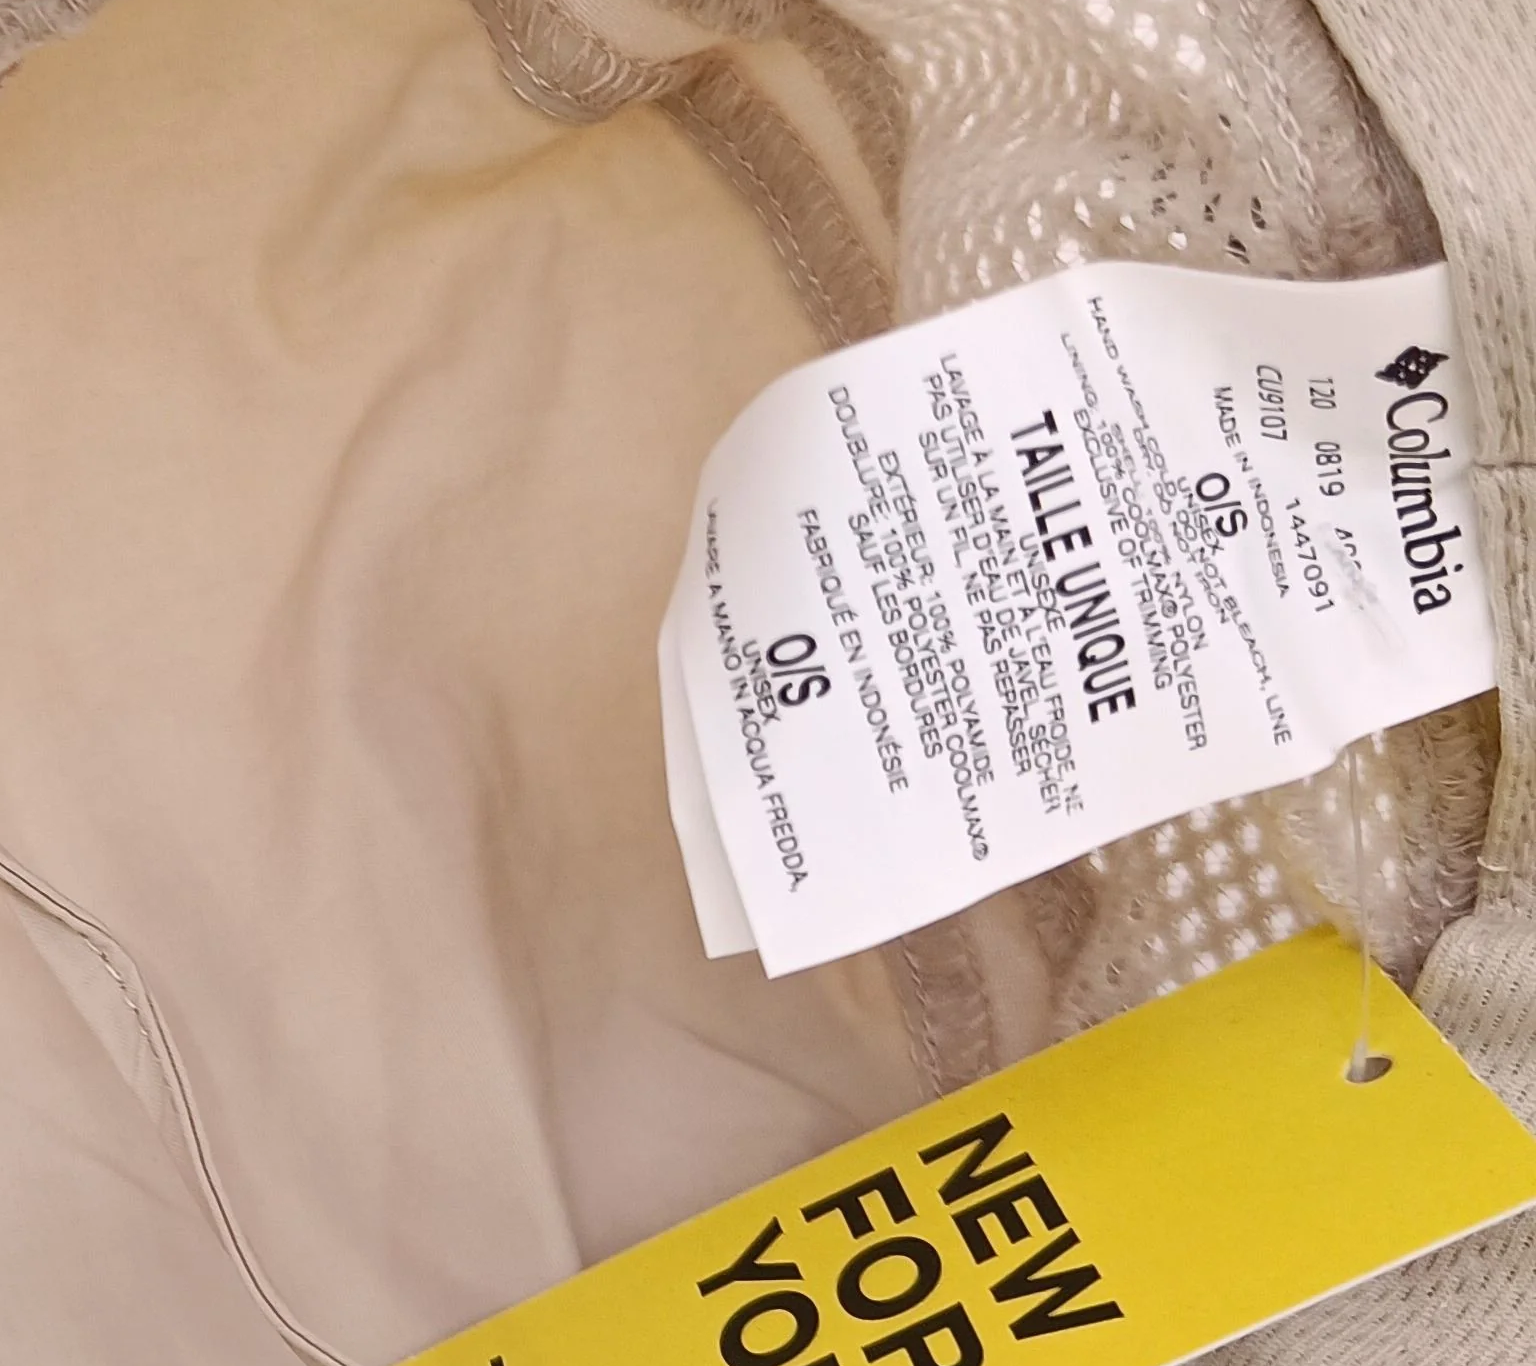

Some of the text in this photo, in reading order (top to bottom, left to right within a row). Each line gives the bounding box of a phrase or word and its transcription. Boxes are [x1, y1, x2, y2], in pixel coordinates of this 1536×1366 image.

[922, 372, 954, 422] PAS
[939, 352, 985, 446] LAVAGE
[917, 429, 950, 483] SUR
[939, 424, 986, 529] UTILISER
[976, 469, 1001, 502] LA
[1211, 384, 1291, 598] MADE IN INDONESIA
[1255, 359, 1335, 613] CU9107 1447091
[1313, 436, 1346, 499] 0819
[934, 485, 961, 522] UN
[987, 505, 1019, 566] MAIN
[1086, 295, 1120, 360] HAND
[1174, 507, 1199, 543] DO
[1194, 547, 1226, 591] NOT
[1222, 594, 1272, 693] BLEACH,
[1264, 693, 1293, 747] LINE
[1175, 475, 1224, 556] UNISEX
[1195, 469, 1251, 538] O/S
[1385, 385, 1464, 615] Columbia
[827, 384, 891, 524] DOUBLURE:
[878, 527, 916, 591] 100%
[900, 595, 958, 730] POLYESTER
[961, 571, 986, 607] NE
[970, 531, 1011, 604] D'EAU
[1004, 568, 1031, 598] ET
[1009, 408, 1138, 724] TAILLE UNIQUE
[1017, 532, 1067, 633] UNISEXE
[1072, 407, 1173, 691] EXCLUSIVE OF TRIMMING
[1096, 419, 1127, 480] 100%
[1164, 623, 1208, 751] POLYESTER
[1168, 520, 1196, 565] NOT
[1193, 570, 1229, 625] IRON
[706, 584, 723, 598] A
[876, 449, 995, 787] EXTÉRIEUR: 100% POLYAMIDE
[972, 607, 1003, 656] PAS
[994, 607, 1022, 642] DE
[1170, 570, 1209, 651] NYLON
[708, 600, 743, 673] MANO
[763, 630, 831, 709] O/S
[796, 508, 909, 794] FABRIQUÉ EN INDONÉSIE
[846, 511, 944, 760] SAUF LES BORDURES
[1023, 624, 1060, 690] L'EAU
[729, 675, 752, 701] IN
[739, 639, 781, 726] UNISEX
[988, 658, 1034, 777] REPASSER
[1006, 643, 1042, 721] JAVEL,
[736, 704, 775, 790] ACQUA
[1042, 692, 1076, 782] FROIDE,
[1062, 782, 1085, 817] NE
[761, 791, 808, 894] FREDDA,
[917, 1113, 1125, 1341] NEW
